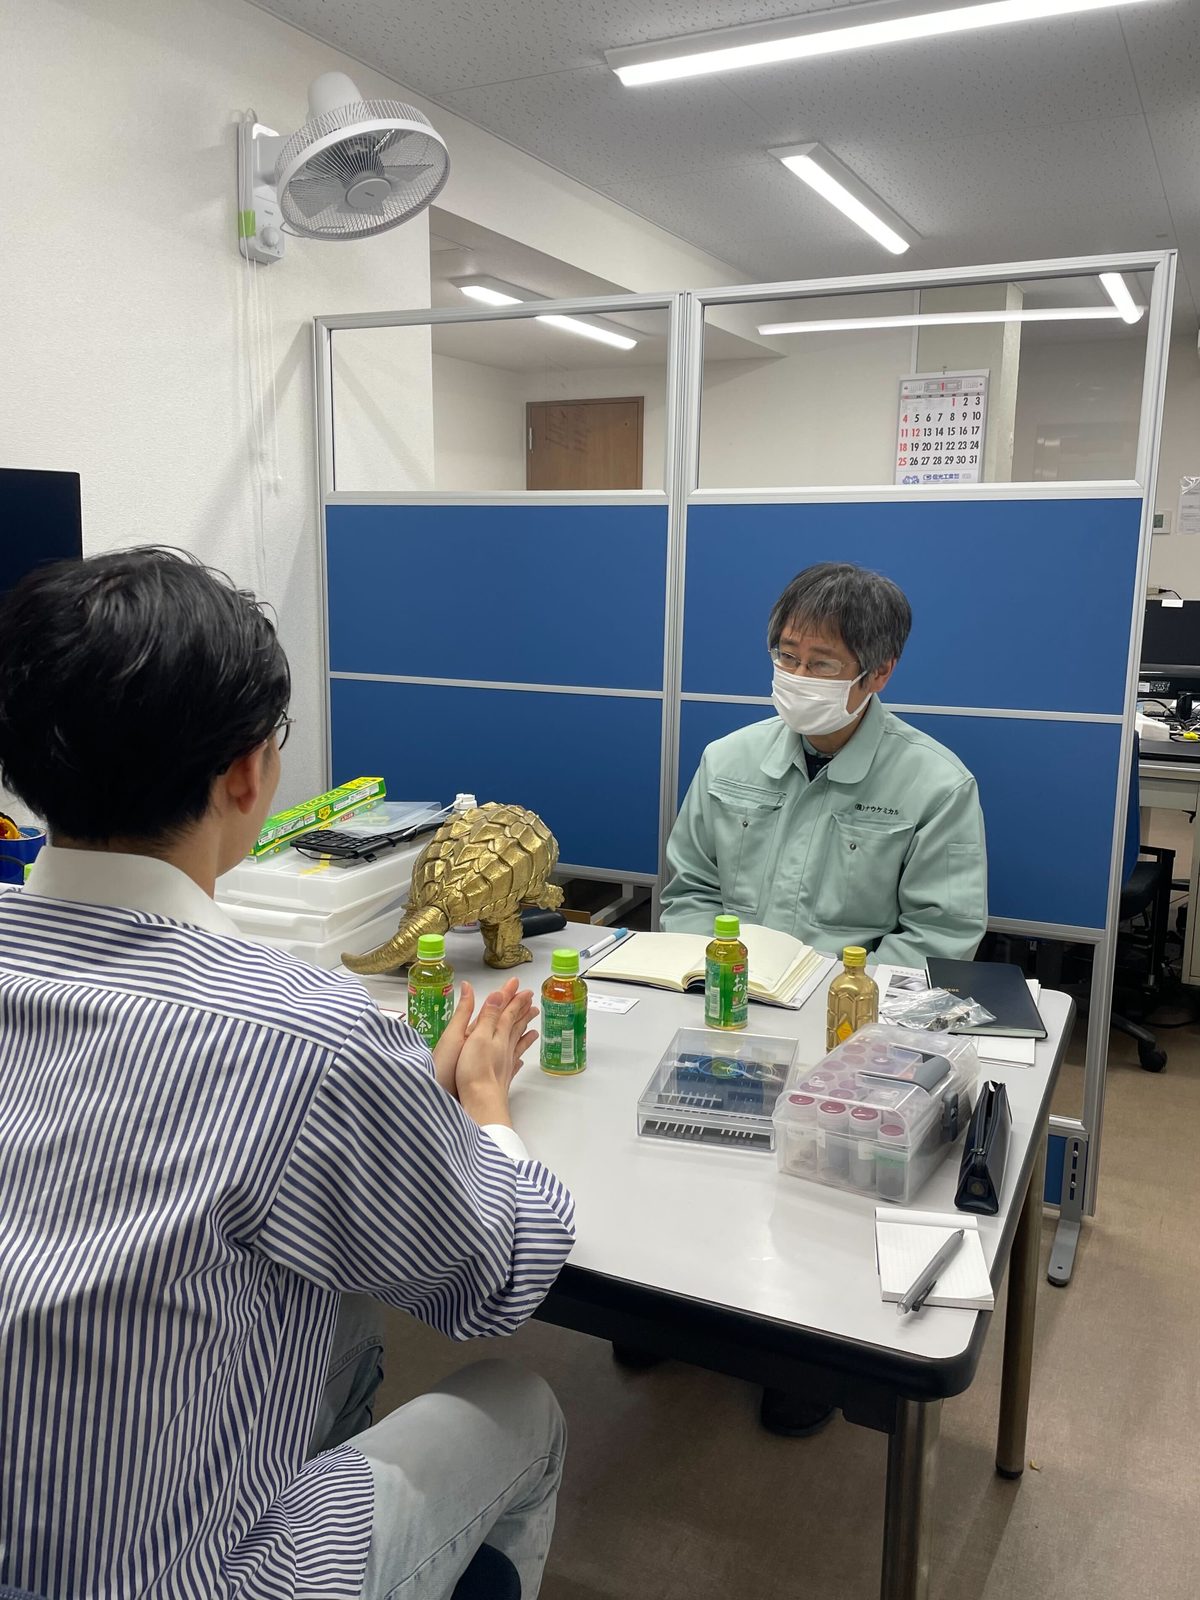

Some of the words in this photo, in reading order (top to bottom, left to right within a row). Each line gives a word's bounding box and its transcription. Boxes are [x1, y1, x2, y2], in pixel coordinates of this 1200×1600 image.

[952, 398, 955, 406] 1
[976, 397, 980, 405] 3
[903, 415, 908, 423] 4
[915, 414, 919, 422] 5
[926, 414, 931, 422] 6
[938, 413, 943, 421] 7
[950, 413, 954, 421] 8
[962, 412, 967, 420] 9
[973, 412, 981, 420] 10
[901, 429, 908, 437] 11
[912, 429, 920, 437] 12
[924, 428, 931, 436] 13
[936, 428, 943, 436] 14
[948, 427, 955, 436] 15
[960, 427, 967, 435] 16
[972, 426, 980, 434] 17
[900, 444, 907, 452] 18
[911, 443, 919, 451] 19
[922, 443, 931, 451] 20
[935, 442, 943, 450] 21
[946, 442, 955, 450] 22
[958, 441, 967, 449] 23
[970, 441, 979, 449] 24
[899, 458, 906, 466] 25
[910, 457, 918, 466] 26
[921, 457, 930, 465] 27
[933, 456, 941, 465] 28
[945, 456, 954, 464] 29
[956, 456, 966, 464] 30
[969, 455, 977, 464] 31
